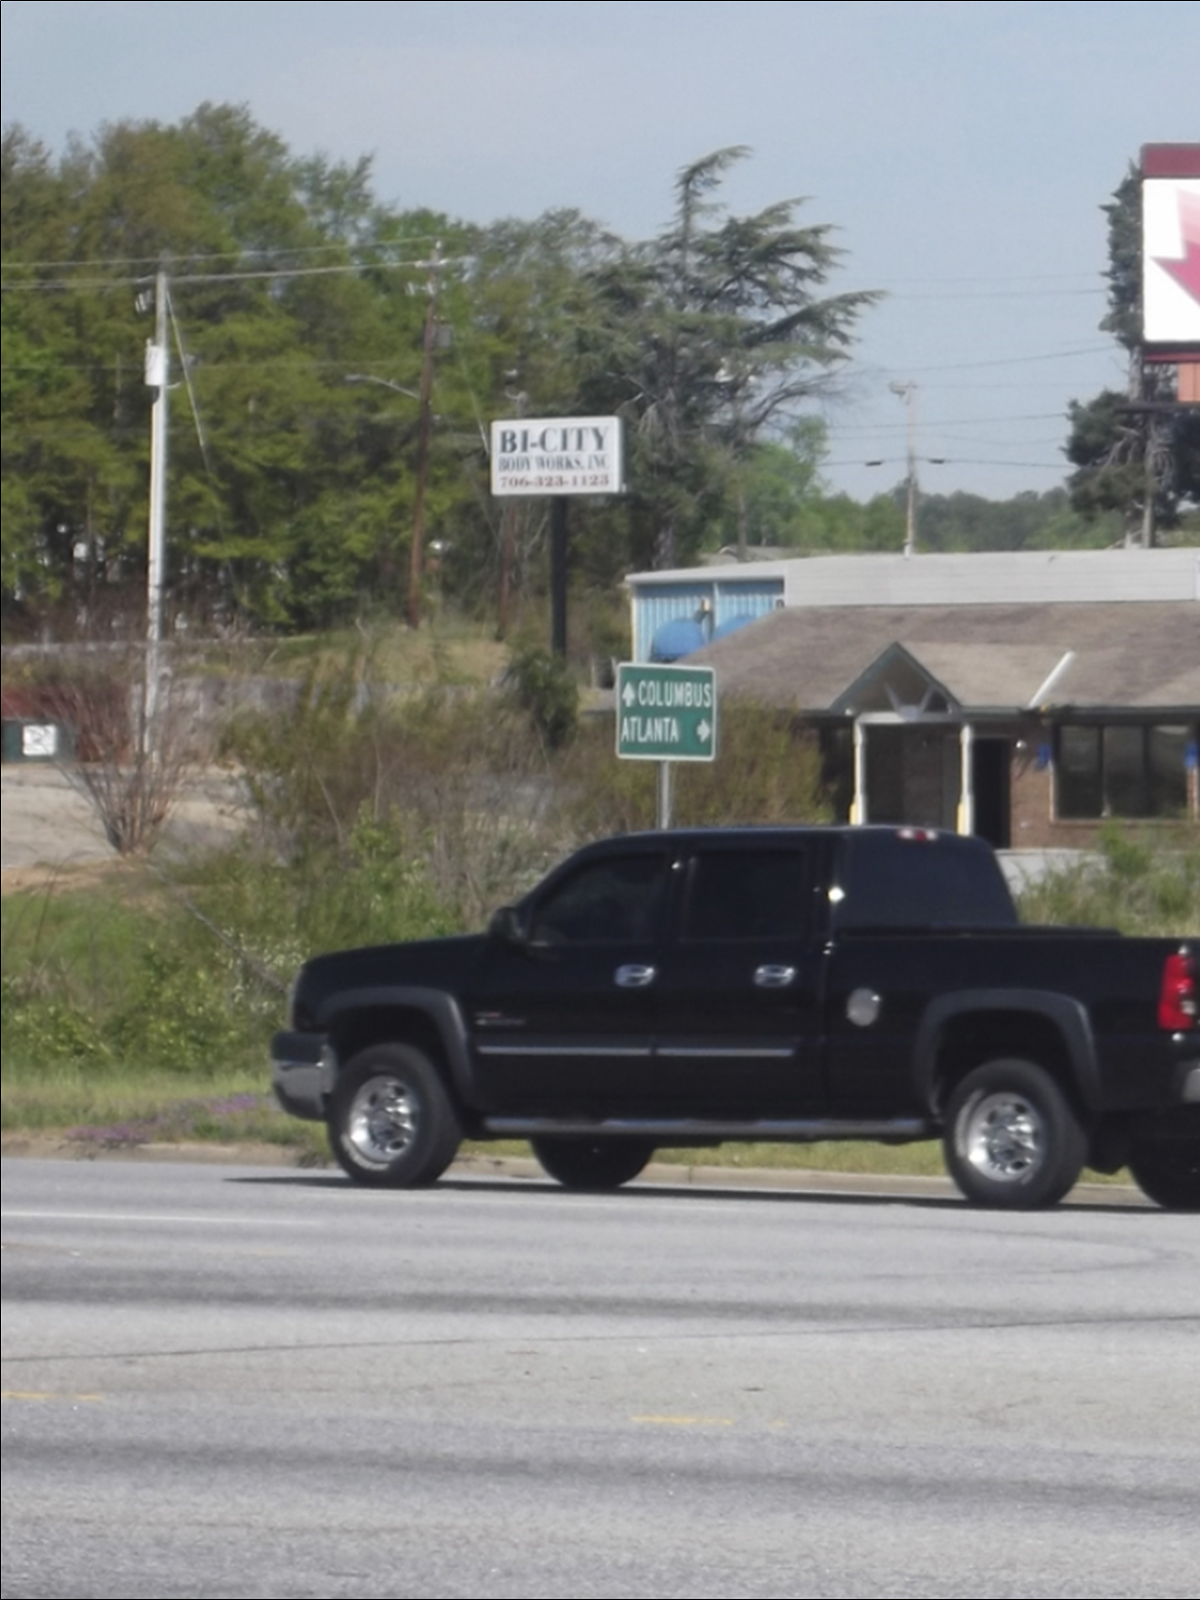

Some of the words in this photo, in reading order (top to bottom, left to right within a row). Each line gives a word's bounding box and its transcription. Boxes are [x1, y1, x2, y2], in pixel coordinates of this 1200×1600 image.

[500, 426, 609, 454] BI-CITY
[498, 455, 532, 472] BODY
[500, 474, 610, 488] 706-323-1123
[638, 680, 712, 708] COLUMBUS
[621, 717, 679, 743] ATLANTA
